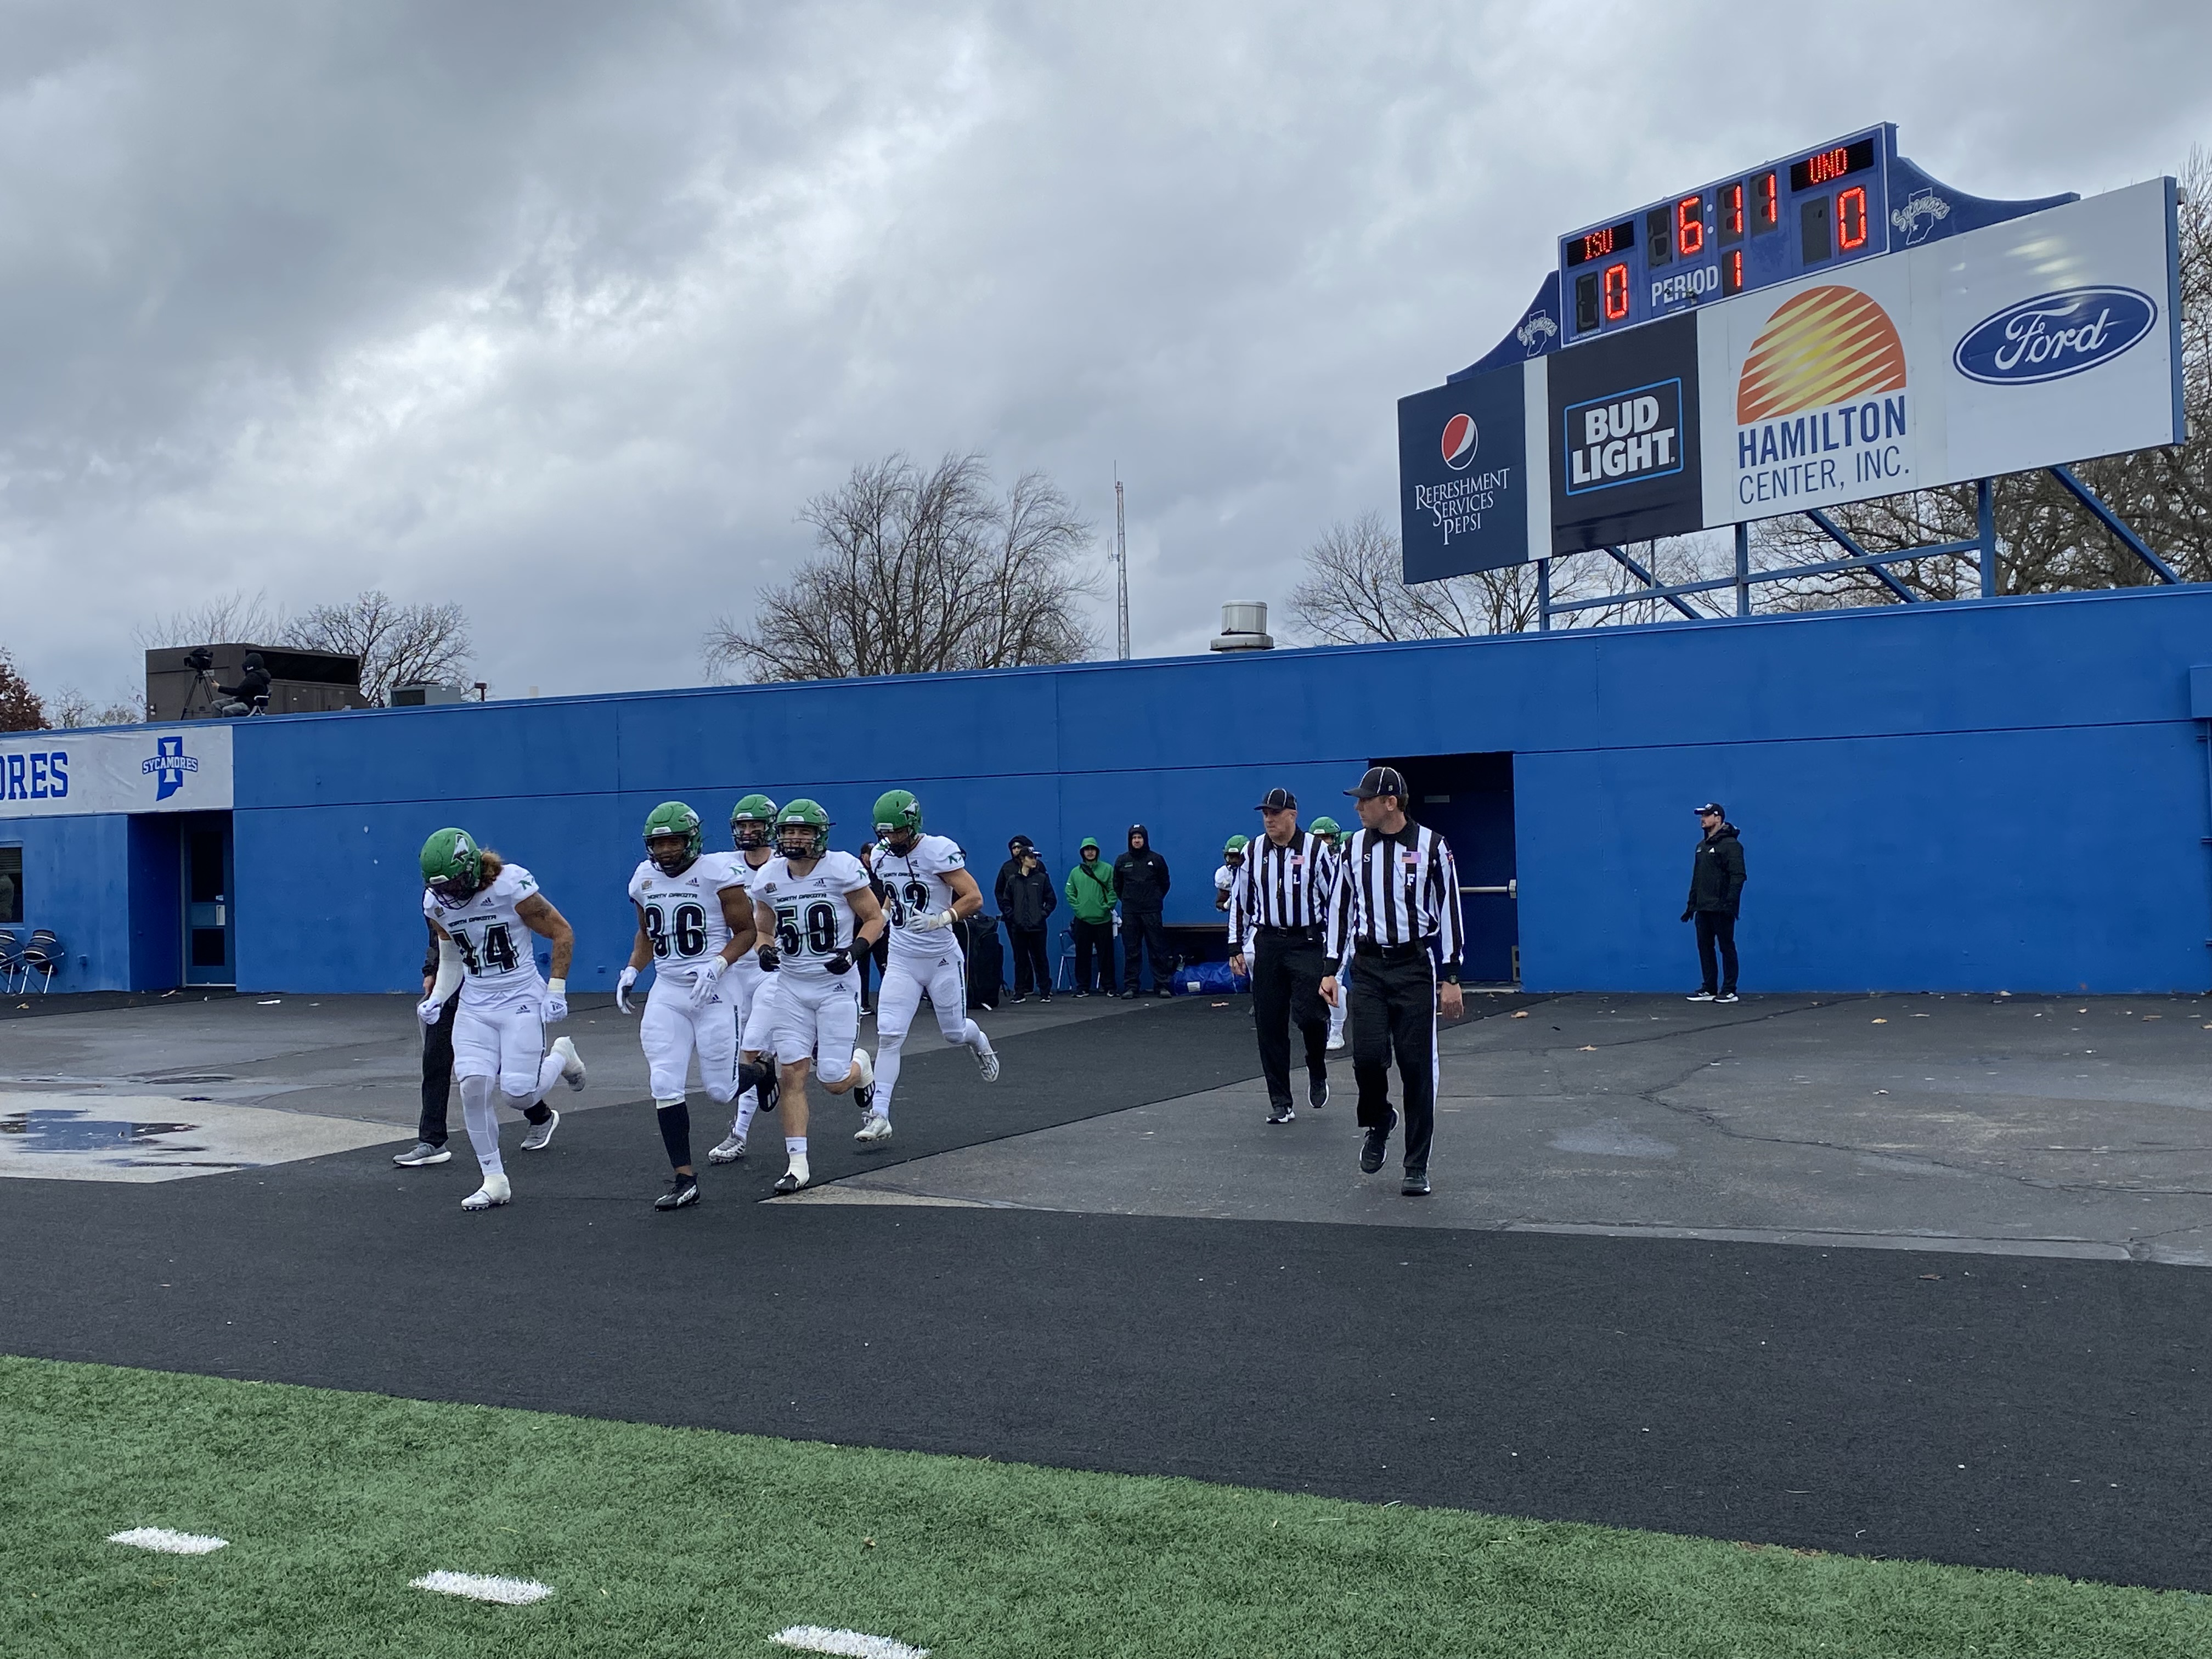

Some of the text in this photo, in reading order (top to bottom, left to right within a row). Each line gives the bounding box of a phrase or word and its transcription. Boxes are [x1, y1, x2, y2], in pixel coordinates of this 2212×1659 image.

[1810, 147, 1848, 184] UND
[1838, 186, 1866, 249] 0
[1584, 227, 1613, 261] ISU
[1605, 264, 1627, 320] 0
[1651, 265, 1719, 307] PERIOD
[1994, 302, 2110, 370] Ford
[1585, 396, 1660, 445] BUD
[1738, 394, 1906, 469] HAMILTON
[1572, 427, 1675, 484] LIGHT
[1740, 445, 1910, 505] CENTER, INC.
[1415, 467, 1510, 510] REFRESHMENT
[1432, 490, 1494, 528] SERVICES
[1443, 512, 1482, 546] PEPSI
[0, 751, 68, 800] RES
[143, 755, 198, 774] SYCAMORES
[1293, 873, 1300, 885] L
[1407, 873, 1415, 887] F
[645, 901, 708, 960] 36
